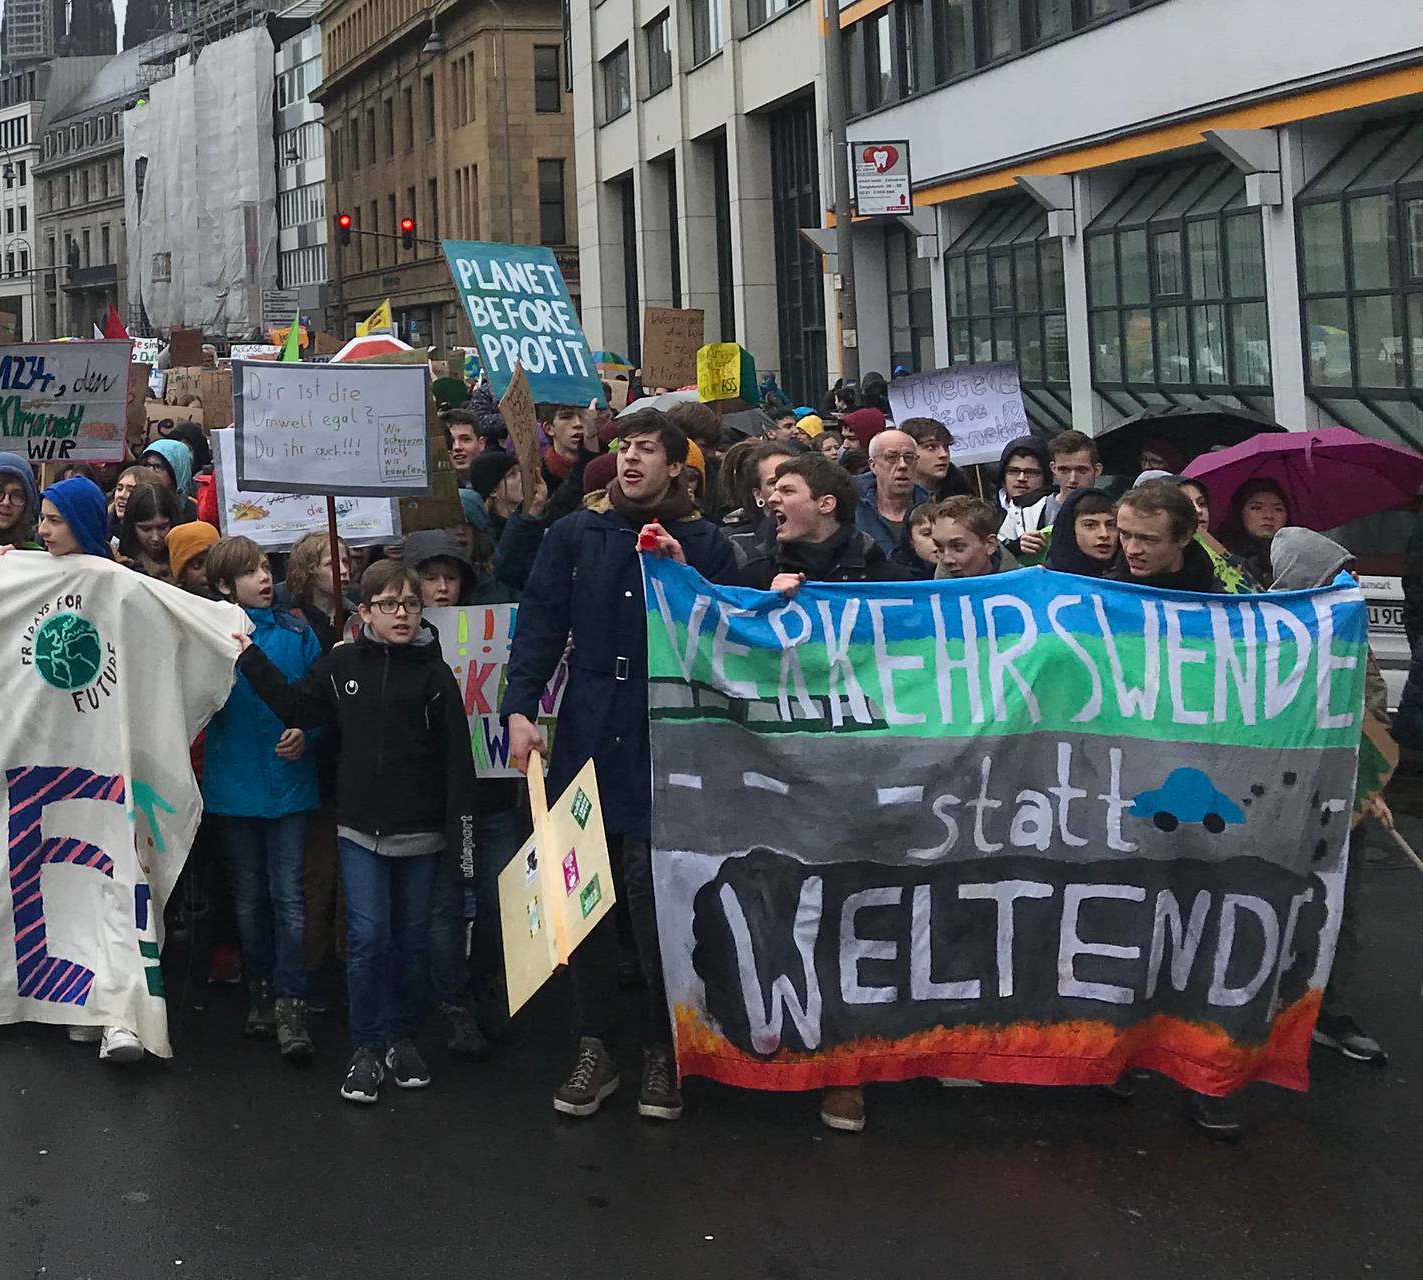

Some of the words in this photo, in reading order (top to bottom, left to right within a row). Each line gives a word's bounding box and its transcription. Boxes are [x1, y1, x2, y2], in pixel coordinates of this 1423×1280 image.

[455, 258, 560, 297] PLANET
[467, 294, 576, 336] BEFORE
[481, 333, 589, 378] PROFIT
[249, 371, 286, 401] Dir
[299, 377, 321, 399] ist
[328, 381, 361, 403] die
[27, 439, 77, 460] WIR
[254, 435, 275, 459] Du
[284, 438, 306, 457] ihr
[307, 505, 325, 517] die
[57, 594, 82, 610] FOR
[1361, 581, 1392, 590] smart
[21, 603, 50, 666] FRIDAYS
[649, 577, 1365, 730] VERKEHRSWENDE
[907, 742, 1141, 859] statt
[461, 815, 475, 877] uhlsport
